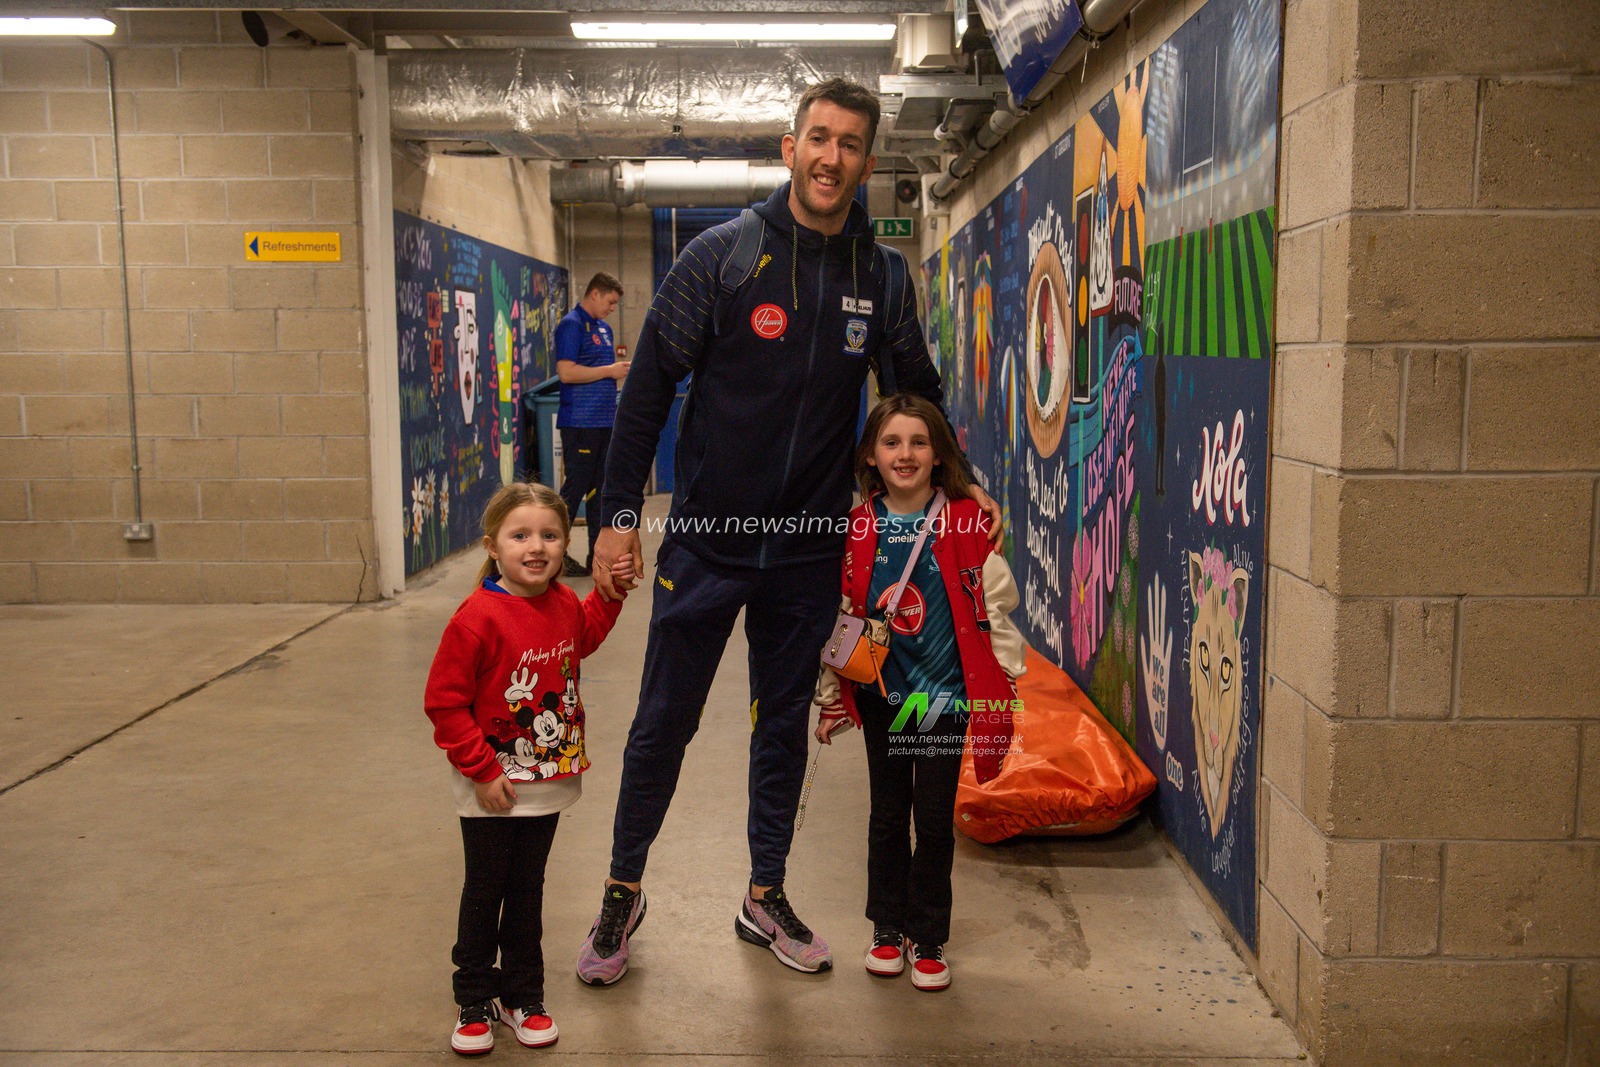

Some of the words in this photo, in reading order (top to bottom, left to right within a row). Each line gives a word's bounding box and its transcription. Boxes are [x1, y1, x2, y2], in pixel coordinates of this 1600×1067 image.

[262, 241, 337, 252] Refreshments
[1113, 275, 1143, 323] FUTURE
[1103, 340, 1129, 431] NEVER
[1082, 441, 1104, 518] LOSE
[1192, 409, 1250, 528] Nola
[1026, 503, 1062, 598] beautiful
[1091, 413, 1135, 655] HOPE
[658, 575, 674, 591] neills
[1180, 548, 1191, 671] Natural
[1025, 564, 1064, 669] destinations
[517, 648, 550, 670] Mickey
[552, 647, 557, 658] &
[557, 638, 575, 661] Friend
[1152, 654, 1165, 683] we
[1152, 681, 1166, 708] are
[1154, 710, 1166, 740] all
[1233, 636, 1252, 805] outrageous
[1167, 759, 1183, 787] one
[1211, 818, 1235, 880] Laughter
